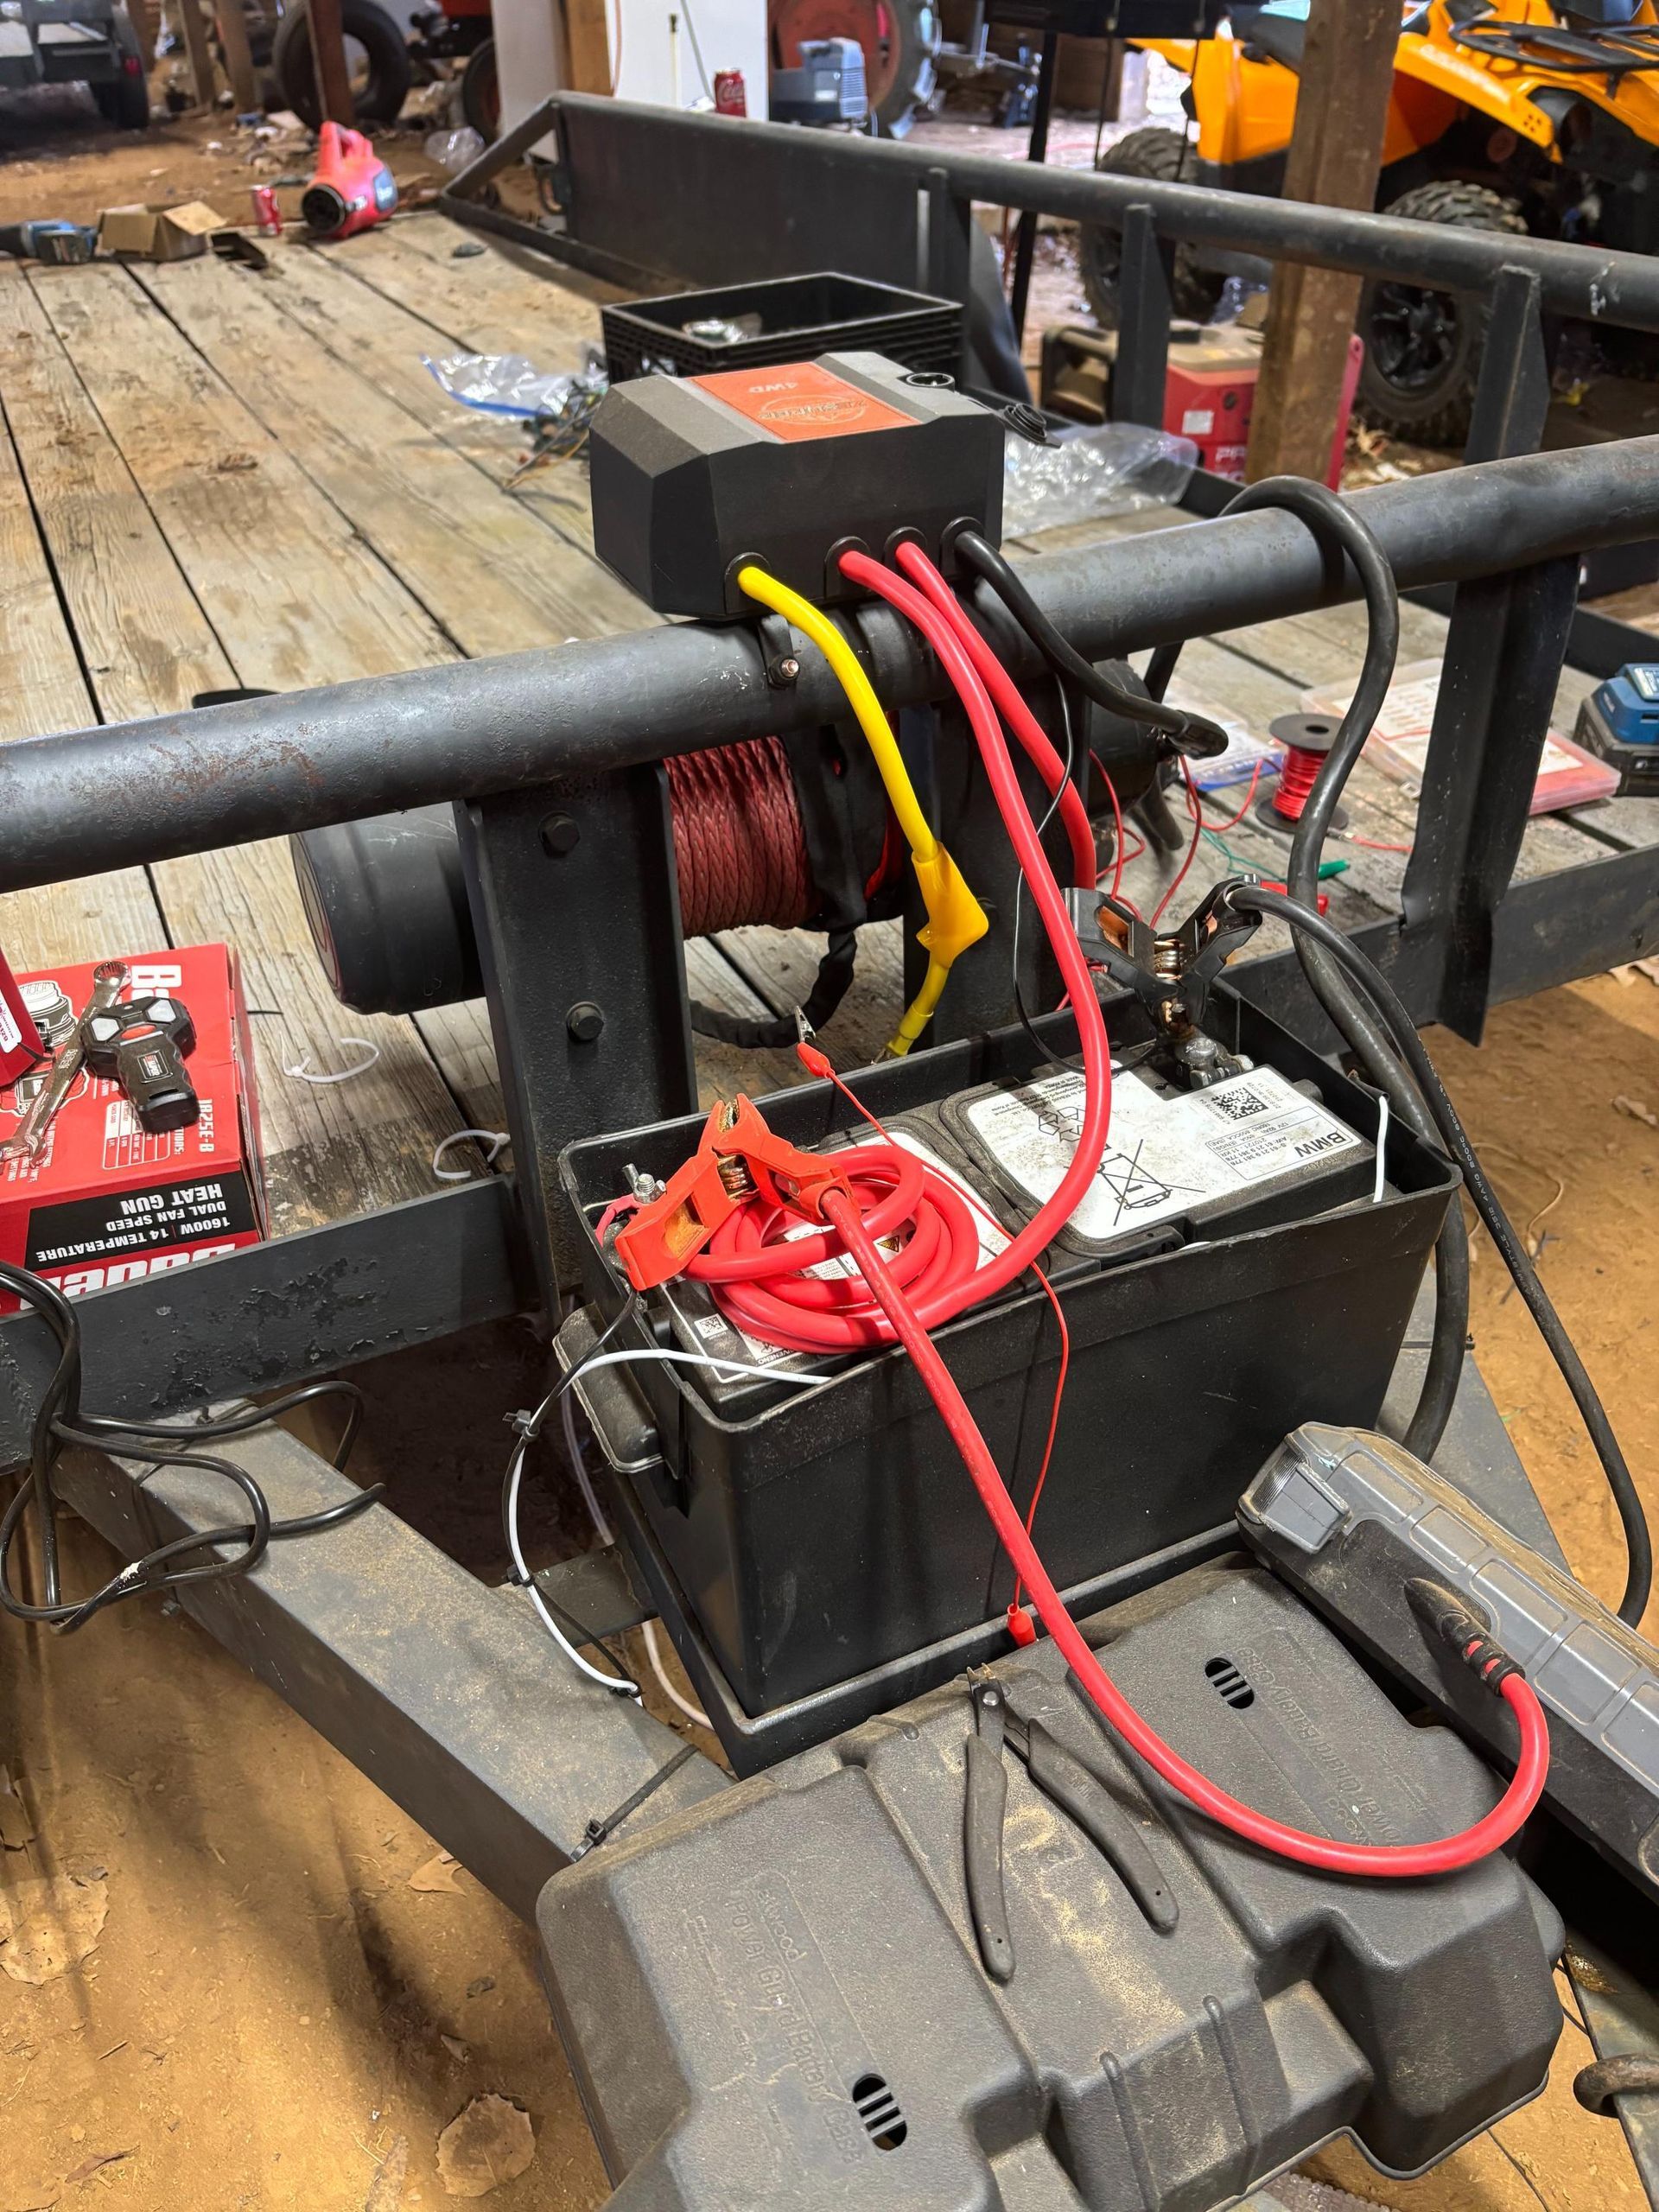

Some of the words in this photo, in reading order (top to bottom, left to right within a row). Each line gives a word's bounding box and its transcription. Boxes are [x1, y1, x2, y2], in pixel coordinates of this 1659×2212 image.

[749, 382, 798, 393] 4WD
[1294, 1132, 1346, 1158] BMW
[172, 1183, 223, 1205] HEAT
[120, 1194, 164, 1215] GUN
[191, 1200, 226, 1216] DUAL
[105, 1214, 153, 1231] SPEED
[157, 1208, 185, 1223] FAN
[151, 1229, 168, 1239] 14
[180, 1217, 231, 1235] 1600W
[36, 1232, 148, 1262] TEMPERATURE
